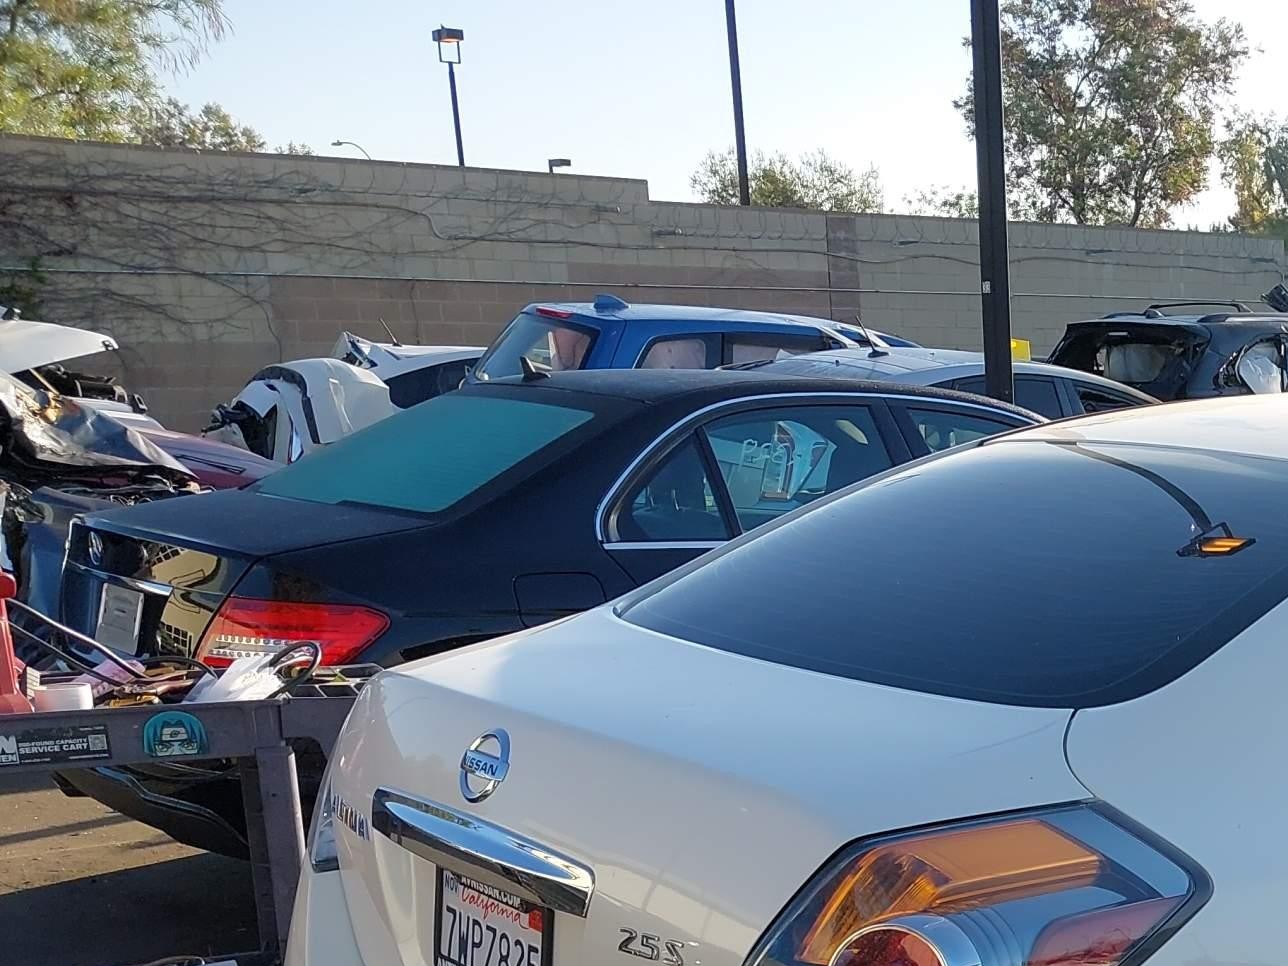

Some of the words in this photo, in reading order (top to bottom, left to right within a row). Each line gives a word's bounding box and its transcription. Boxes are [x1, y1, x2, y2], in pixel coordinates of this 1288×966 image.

[19, 745, 61, 755] SERVICE
[62, 743, 89, 751] CART
[461, 887, 529, 929] California
